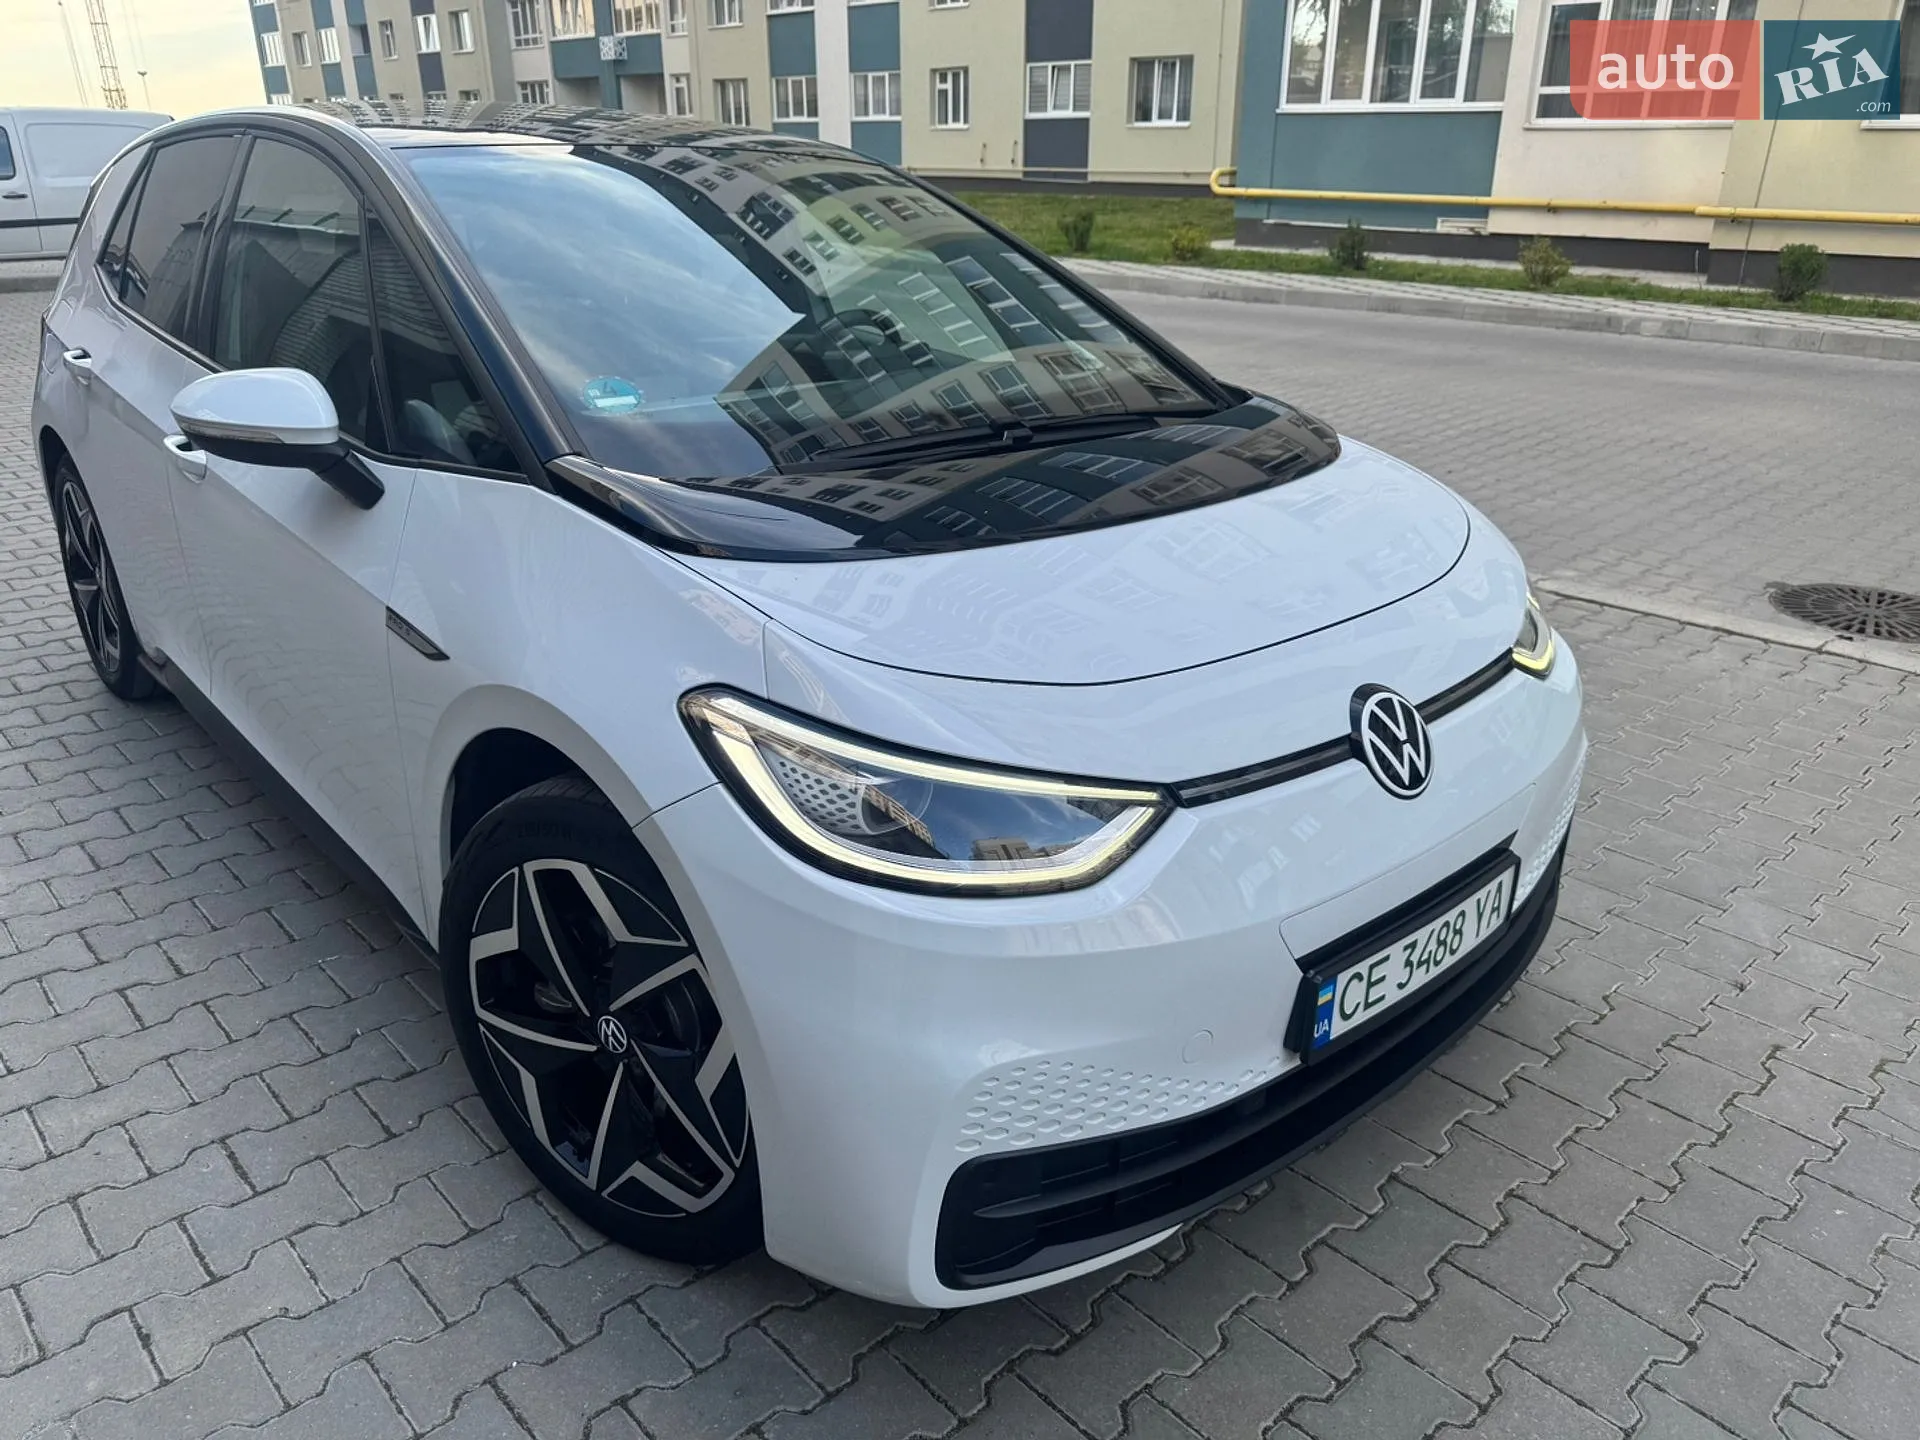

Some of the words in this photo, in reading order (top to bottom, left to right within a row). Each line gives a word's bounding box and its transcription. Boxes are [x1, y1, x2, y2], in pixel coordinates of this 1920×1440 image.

[1339, 954, 1391, 1021] CE
[1397, 909, 1466, 990] 3488
[1475, 879, 1503, 938] YA
[1314, 1018, 1329, 1038] UA
